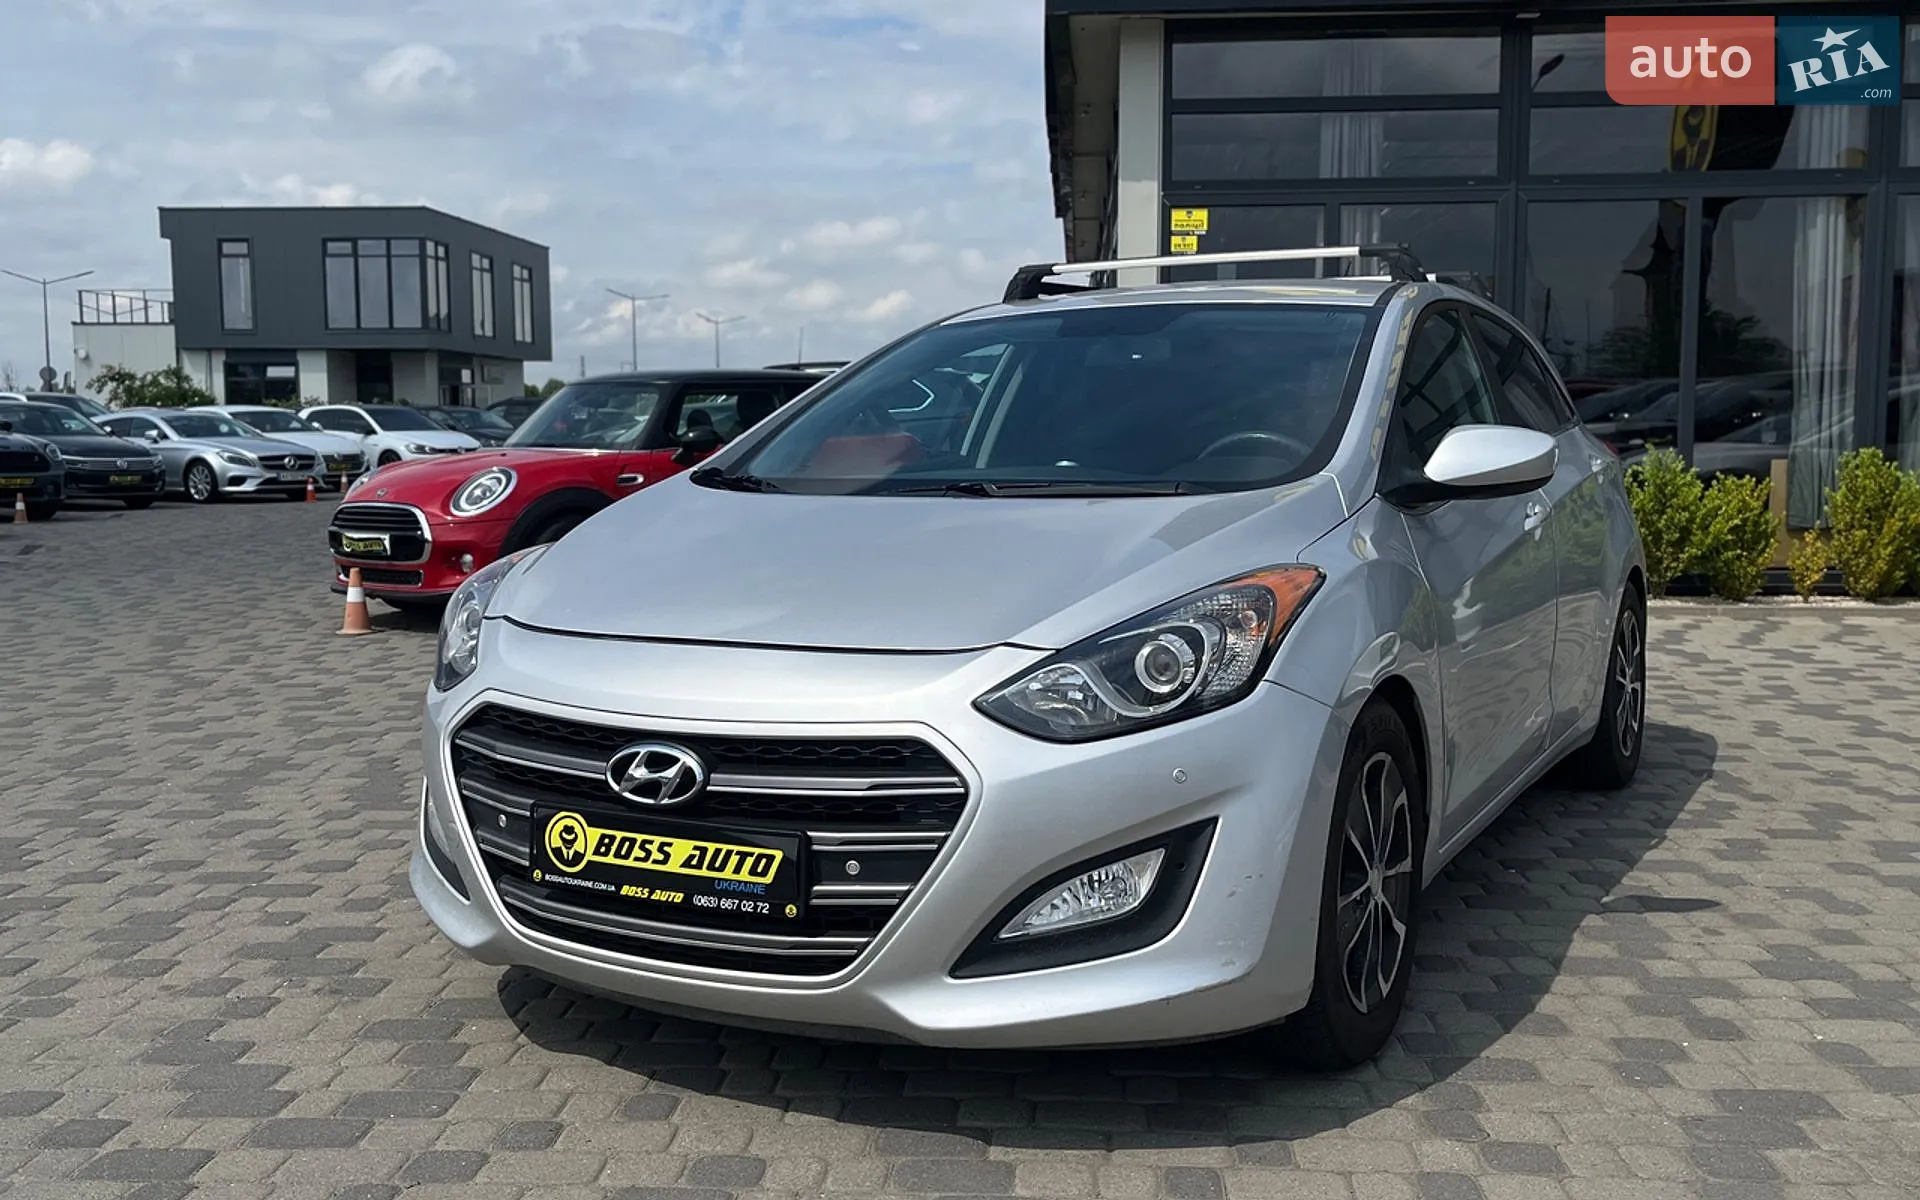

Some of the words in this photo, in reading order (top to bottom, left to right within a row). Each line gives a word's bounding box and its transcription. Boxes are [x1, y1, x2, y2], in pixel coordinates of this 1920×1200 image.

[592, 833, 675, 866] BOSS
[679, 844, 777, 879] AUTO
[620, 884, 651, 899] BOSS
[650, 889, 685, 904] AUTO
[714, 880, 767, 895] UKRAINE
[693, 894, 719, 908] (063)
[720, 898, 740, 911] 667
[741, 900, 755, 913] 02
[755, 901, 770, 915] 72
